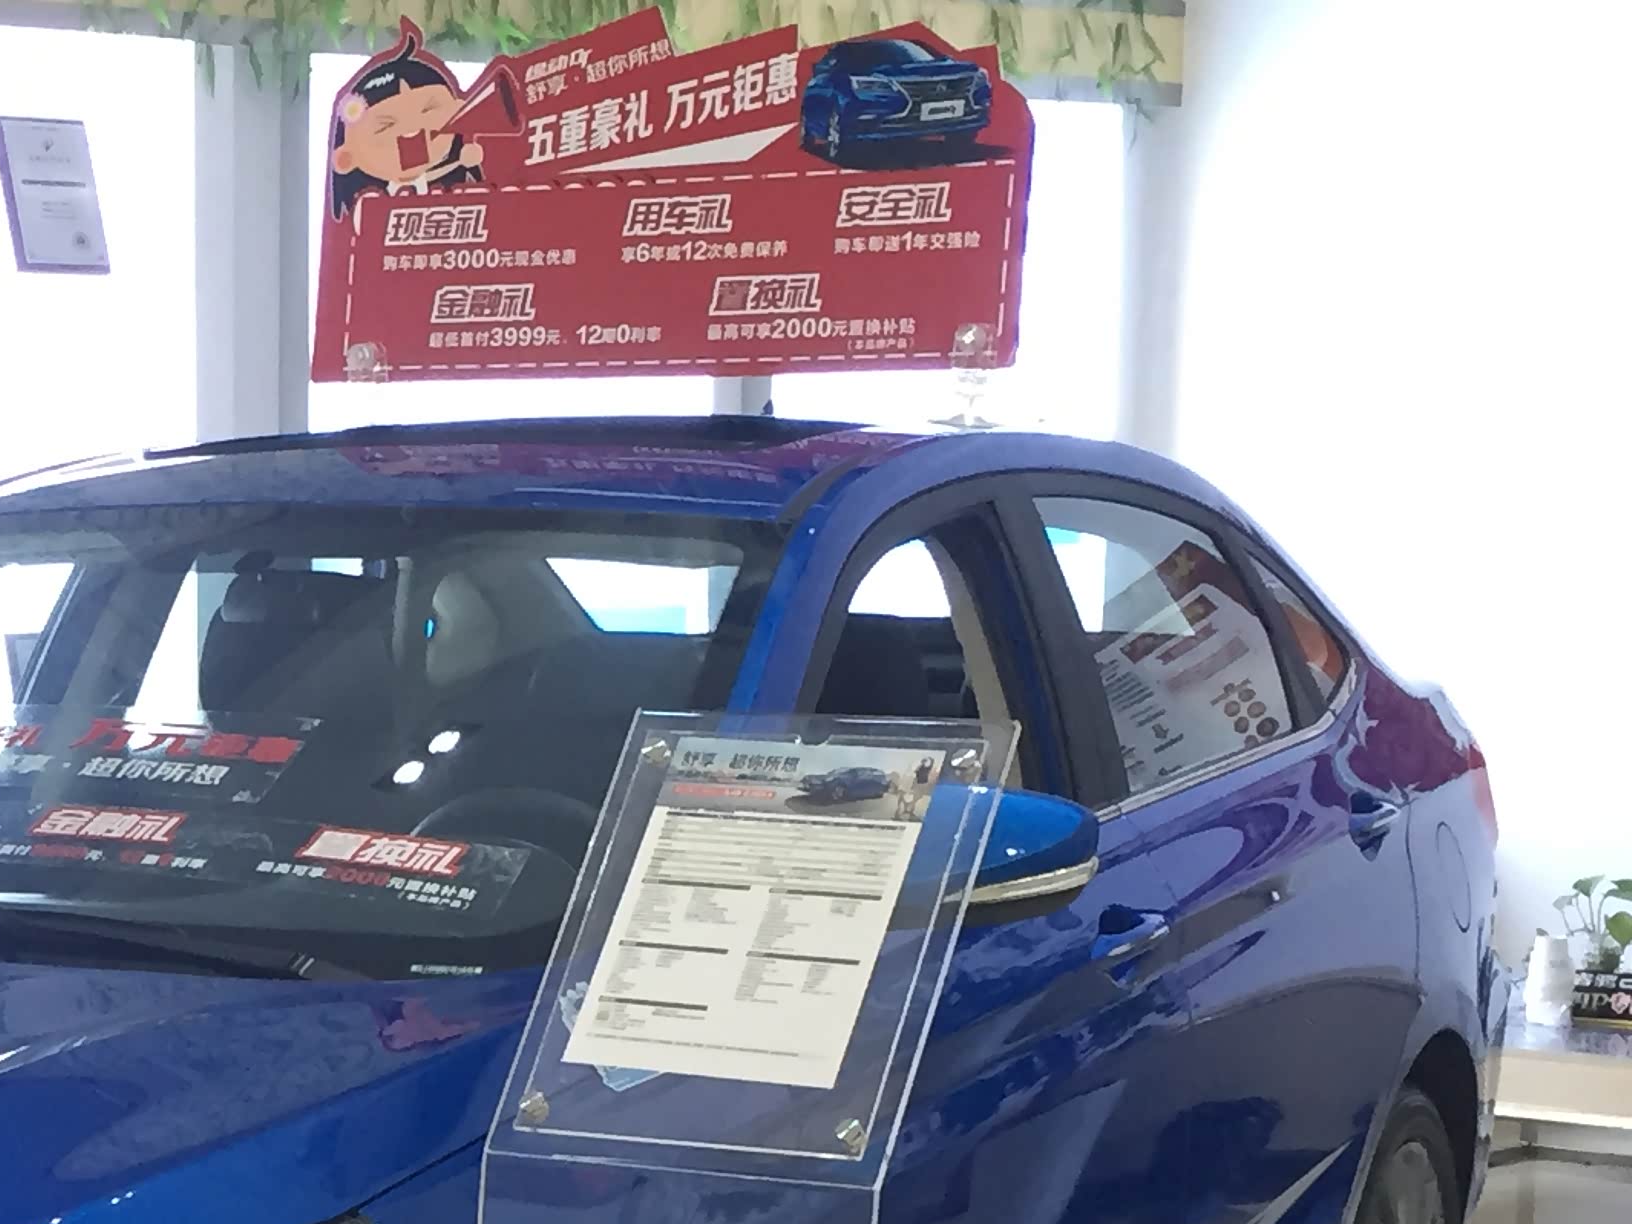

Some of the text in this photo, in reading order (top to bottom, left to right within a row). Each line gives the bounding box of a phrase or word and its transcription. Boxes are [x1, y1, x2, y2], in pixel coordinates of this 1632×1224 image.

[524, 51, 800, 166] 五重豪礼 万元钜惠
[625, 196, 732, 234] 用车礼
[838, 184, 951, 225] 安全礼
[386, 206, 488, 245] 现金礼
[834, 231, 981, 255] 购车即送1年交强险
[432, 284, 534, 321] 金融礼
[711, 275, 821, 314] 置换礼
[707, 317, 915, 341] 最高可享2000元置换补贴
[76, 757, 230, 786] 超你所想
[31, 807, 182, 843] 金融礼
